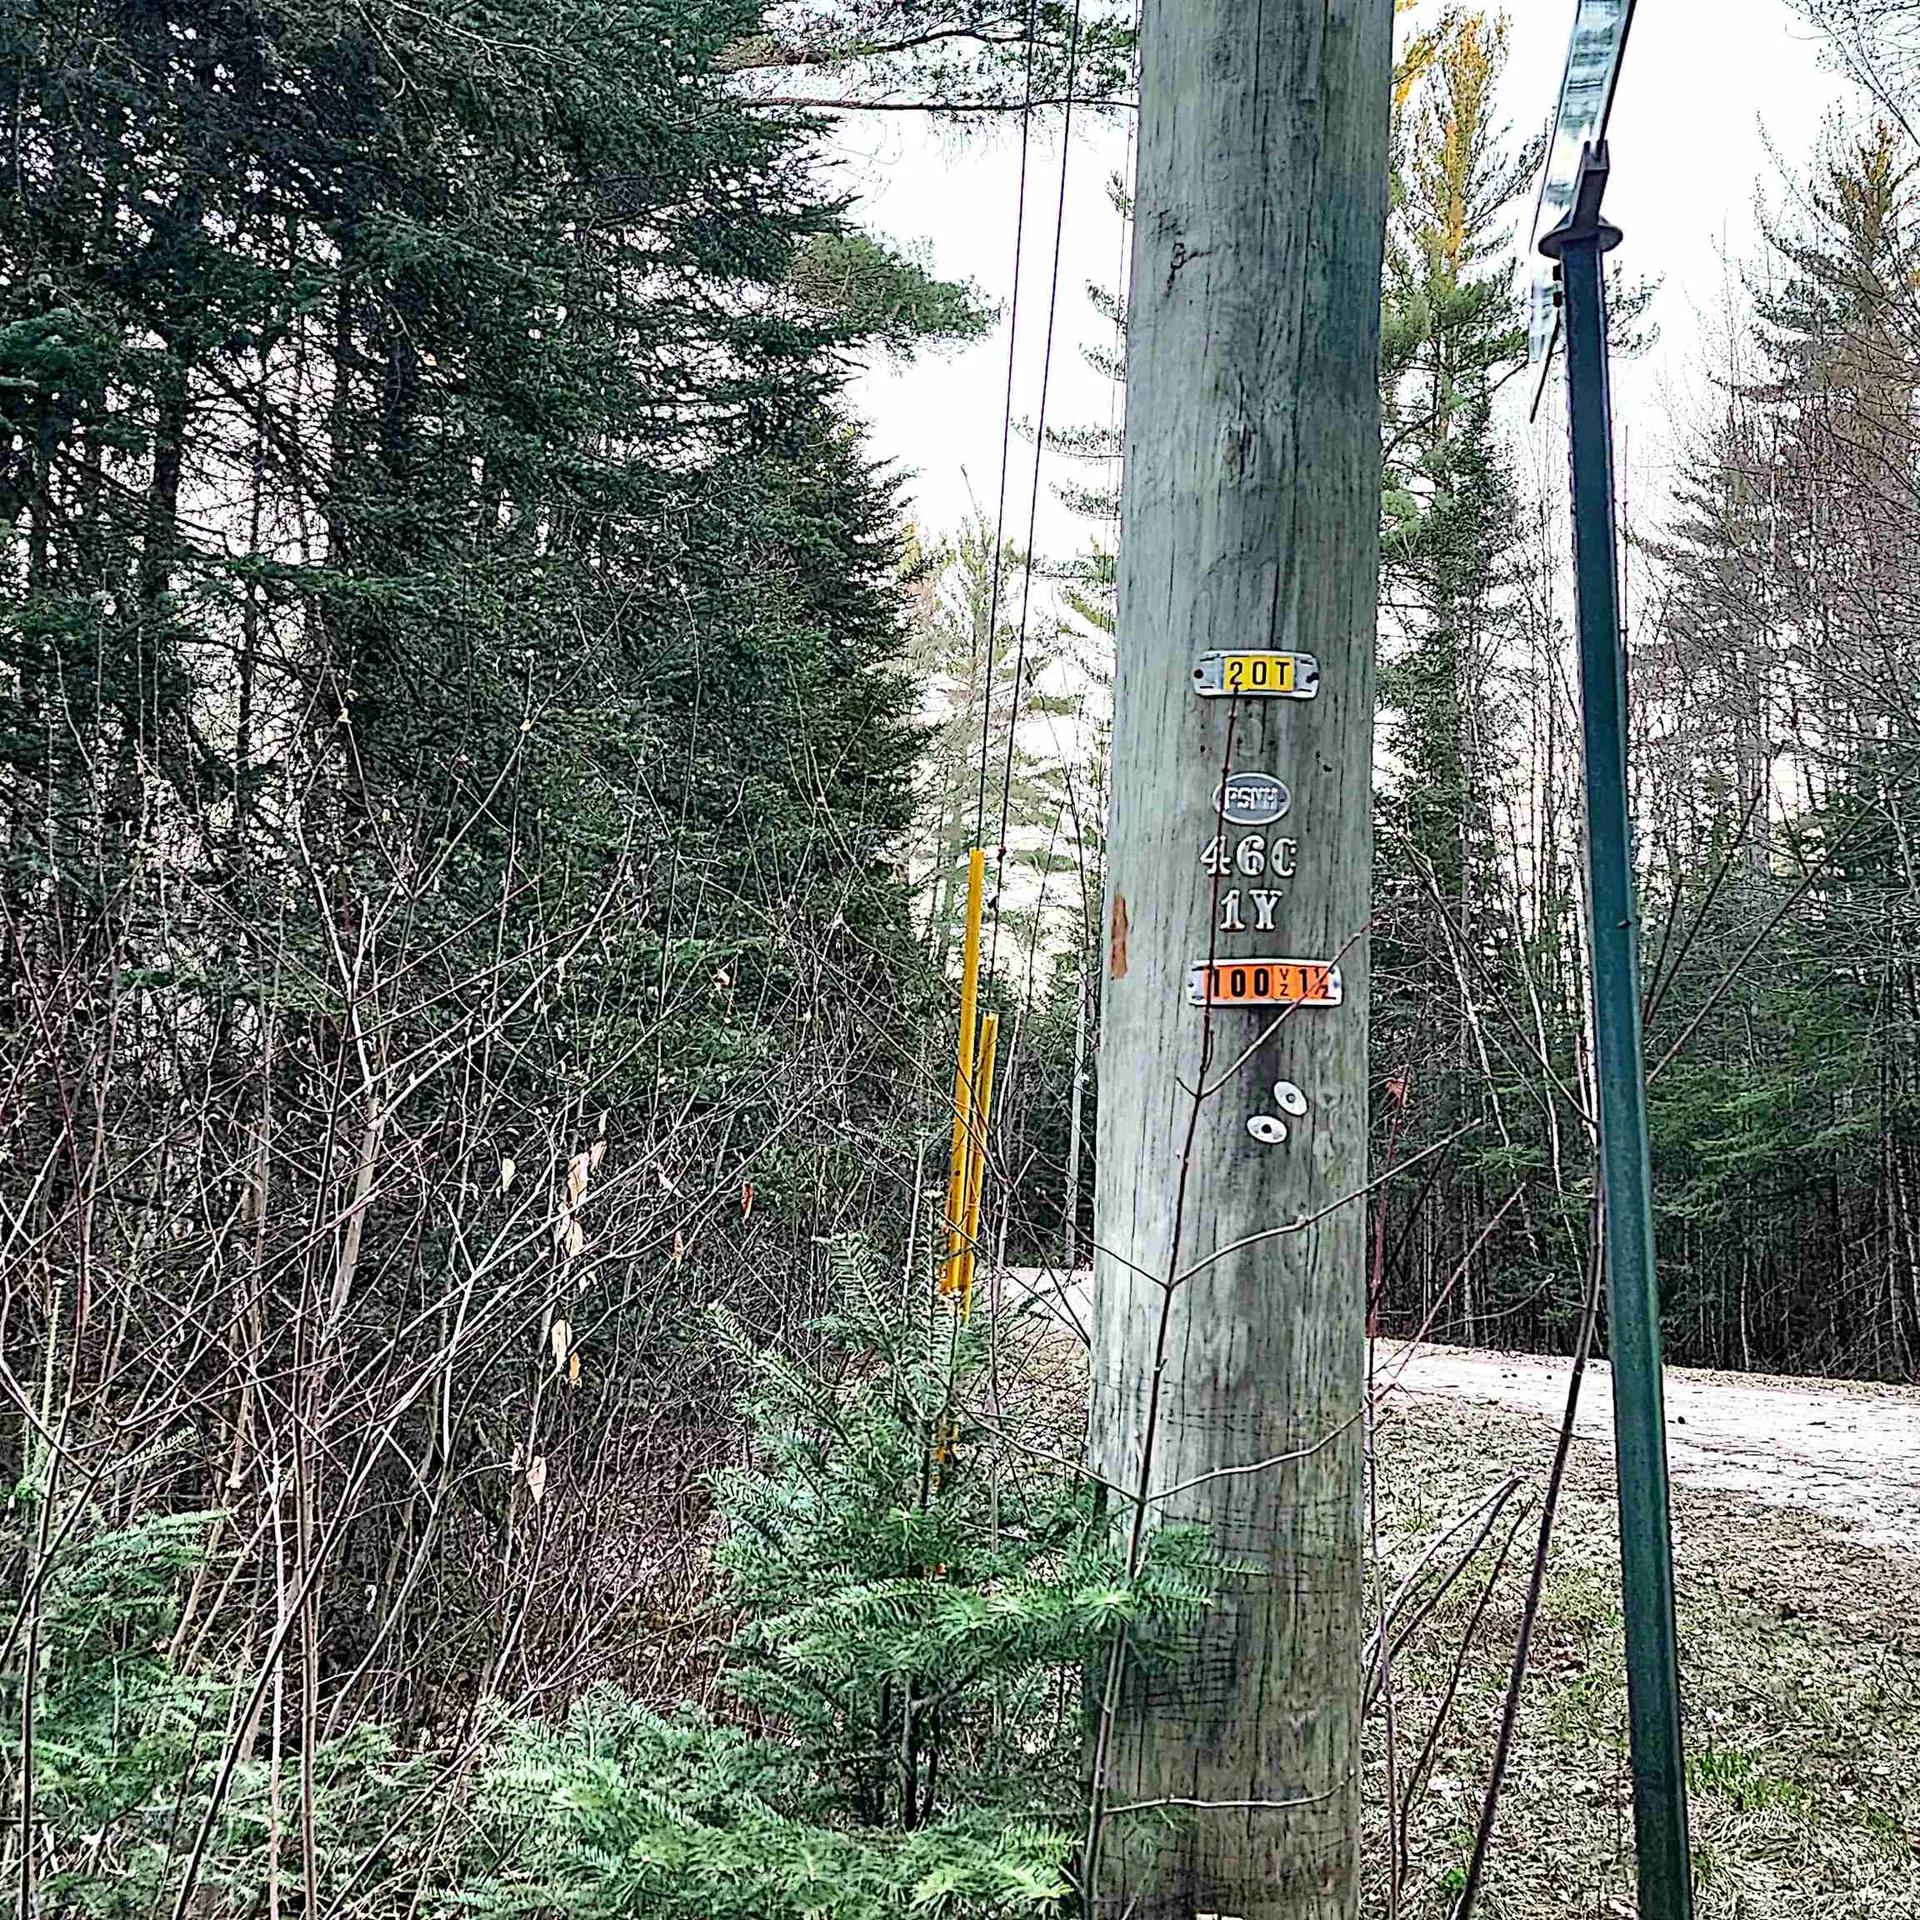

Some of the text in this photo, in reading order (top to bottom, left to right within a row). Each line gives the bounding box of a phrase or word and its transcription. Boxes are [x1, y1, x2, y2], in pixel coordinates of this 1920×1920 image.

[1229, 661, 1290, 686] 20T
[1200, 834, 1298, 878] 46C
[1219, 889, 1284, 931] 1Y
[1213, 968, 1270, 998] 100
